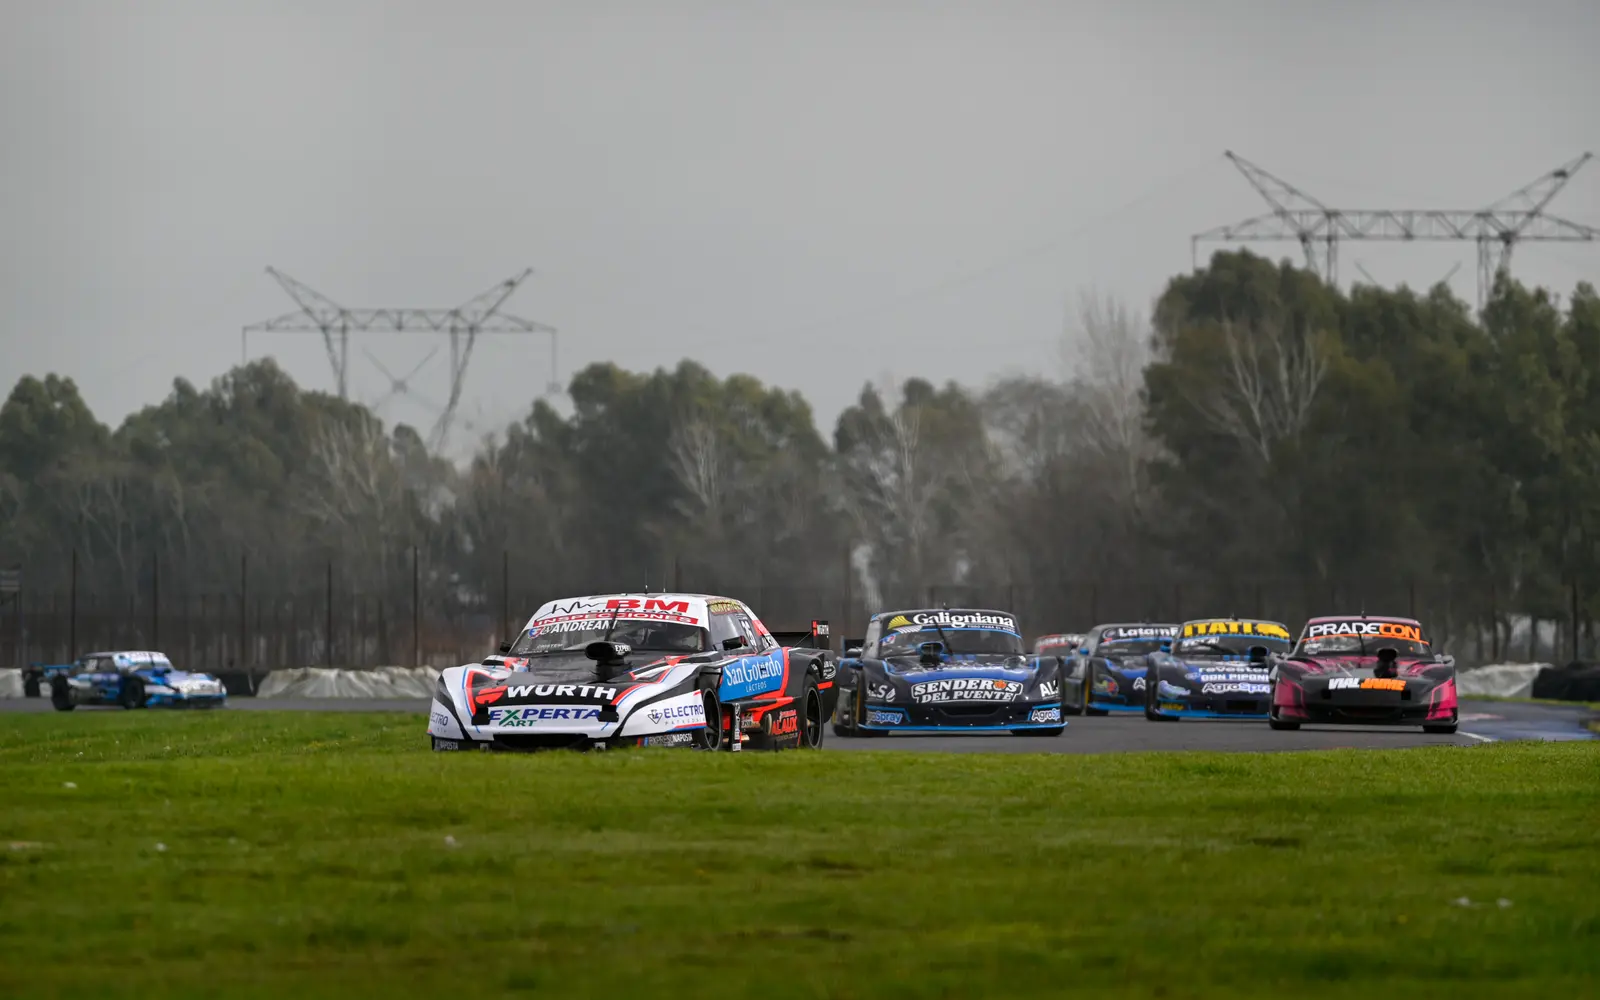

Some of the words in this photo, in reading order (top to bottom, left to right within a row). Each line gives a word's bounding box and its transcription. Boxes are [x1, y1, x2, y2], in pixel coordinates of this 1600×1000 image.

[605, 599, 690, 613] BM
[537, 612, 693, 624] INSPECCIONES
[913, 612, 1015, 628] Galigniana
[1309, 622, 1420, 640] PRADECON
[724, 665, 744, 686] San
[742, 655, 782, 682] Gotrdo
[1328, 677, 1360, 690] VIAL
[921, 691, 950, 704] DEL
[953, 689, 1013, 700] PUENTE
[664, 704, 704, 719] ELECTRO
[501, 719, 537, 728] ART
